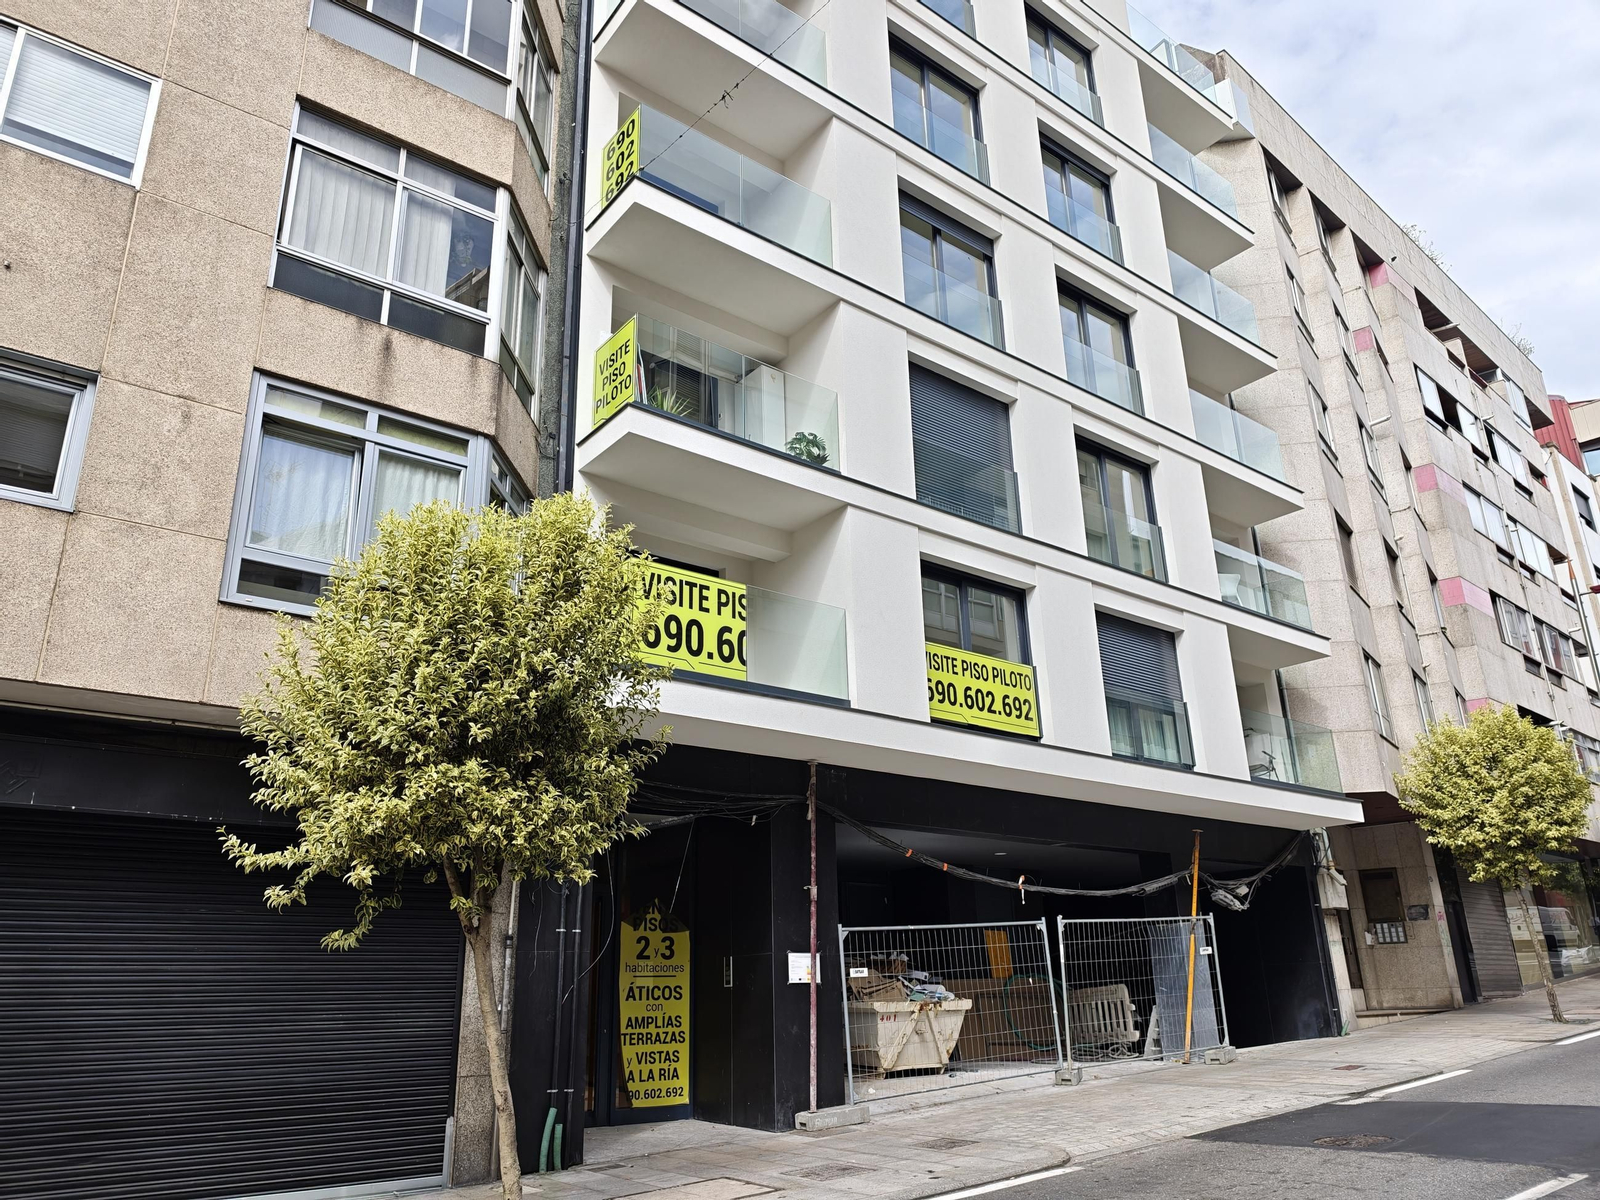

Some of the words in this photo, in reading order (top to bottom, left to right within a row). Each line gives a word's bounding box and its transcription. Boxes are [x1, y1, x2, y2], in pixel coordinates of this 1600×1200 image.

[607, 119, 635, 161] 690
[606, 140, 634, 182] 602
[605, 160, 634, 202] 692
[599, 338, 631, 376] VISITE
[602, 361, 626, 391] PISO
[595, 374, 632, 414] PILOTO
[642, 572, 710, 613] VISITE
[961, 660, 989, 682] PISO
[992, 666, 1032, 691] PILOTO
[636, 935, 651, 960] 2
[654, 947, 660, 958] y
[660, 935, 675, 960] 3
[625, 962, 685, 973] habitaciones
[625, 981, 683, 1001] ÁTICOS
[625, 1012, 682, 1030] AMPLÍAS
[645, 1003, 663, 1012] con
[621, 1030, 686, 1046] TERRAZAS
[626, 1058, 632, 1069] y
[636, 1050, 680, 1065] VISTAS
[627, 1070, 635, 1083] A
[639, 1068, 655, 1082] LA
[659, 1064, 680, 1081] RÍA
